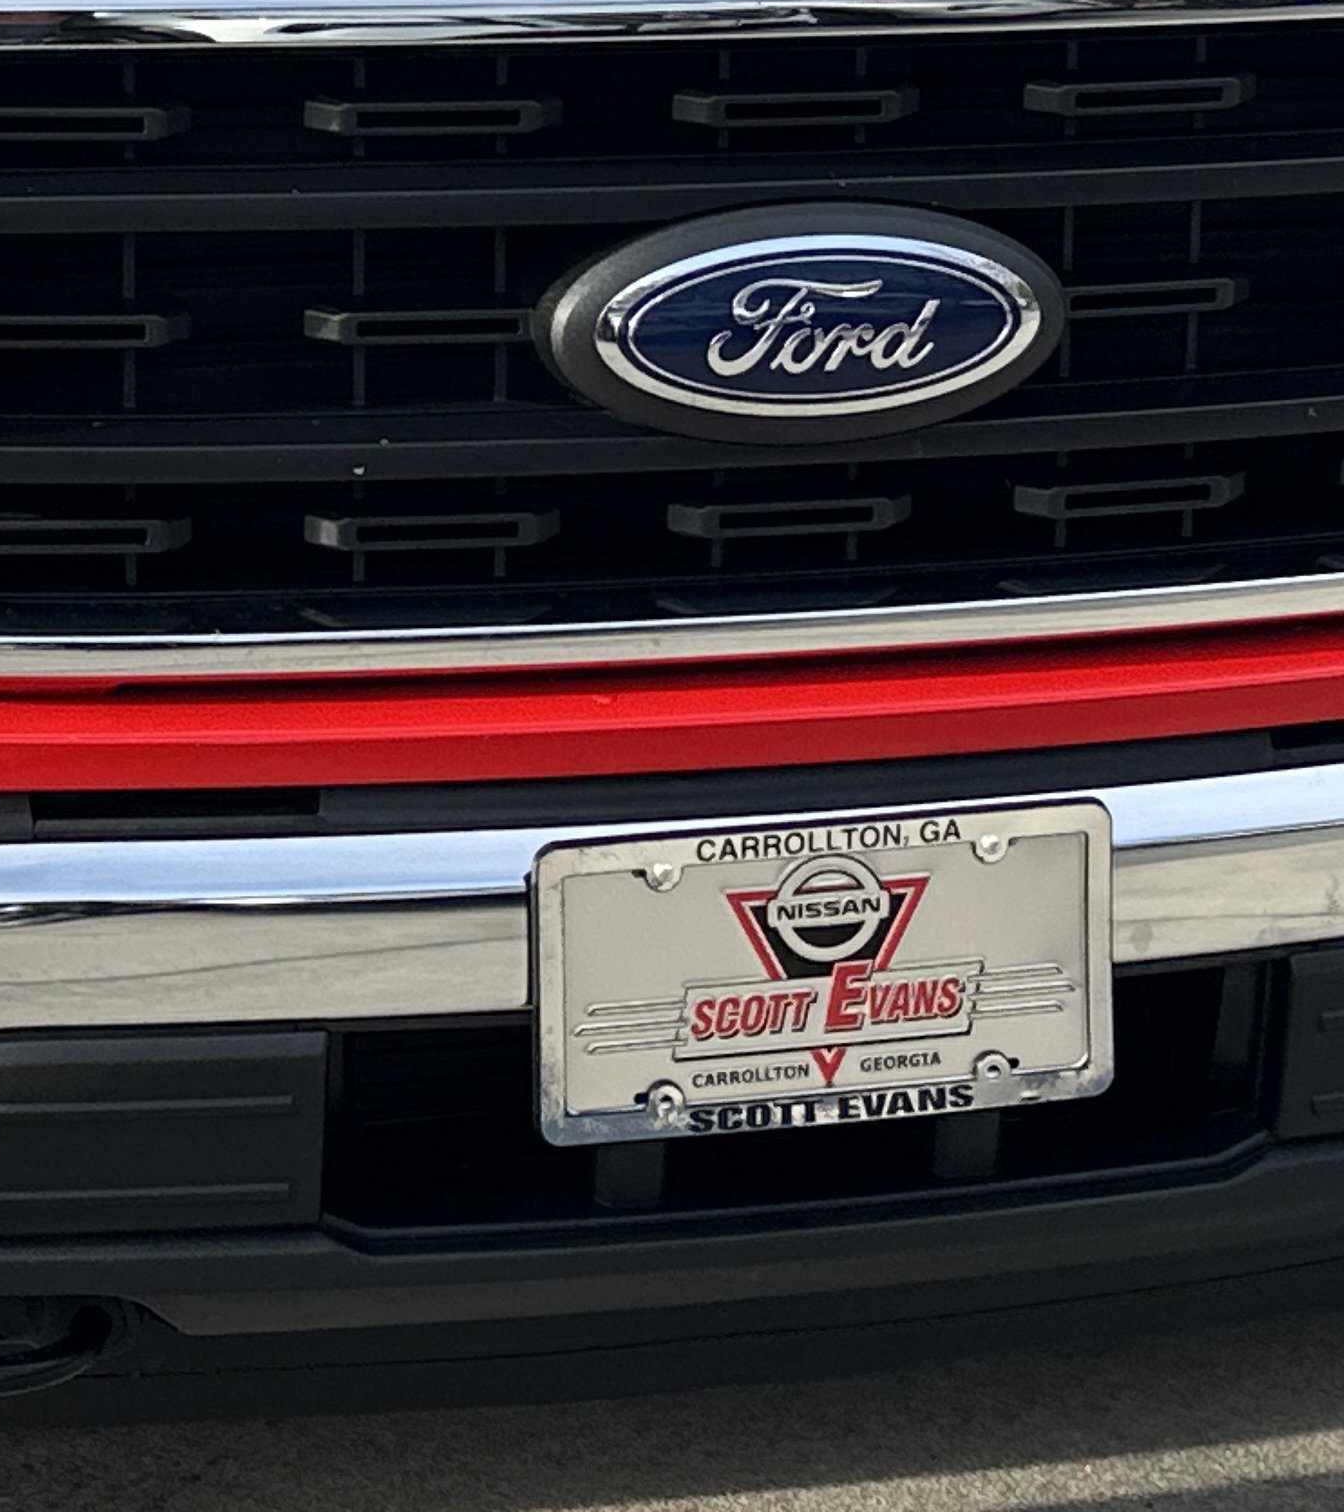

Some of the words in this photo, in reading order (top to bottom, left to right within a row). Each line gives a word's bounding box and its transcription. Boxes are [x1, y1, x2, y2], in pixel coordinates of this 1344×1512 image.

[707, 278, 941, 376] Ford
[696, 823, 910, 863] CARROLLTON,
[919, 819, 962, 844] GA
[775, 896, 882, 921] NISSAN
[690, 990, 817, 1041] SCOTT
[823, 961, 965, 1034] EVANS
[692, 1064, 810, 1088] CARROLLTON
[859, 1052, 941, 1072] GEORGIA
[689, 1097, 823, 1133] SCOTT
[838, 1085, 974, 1120] EVANS
